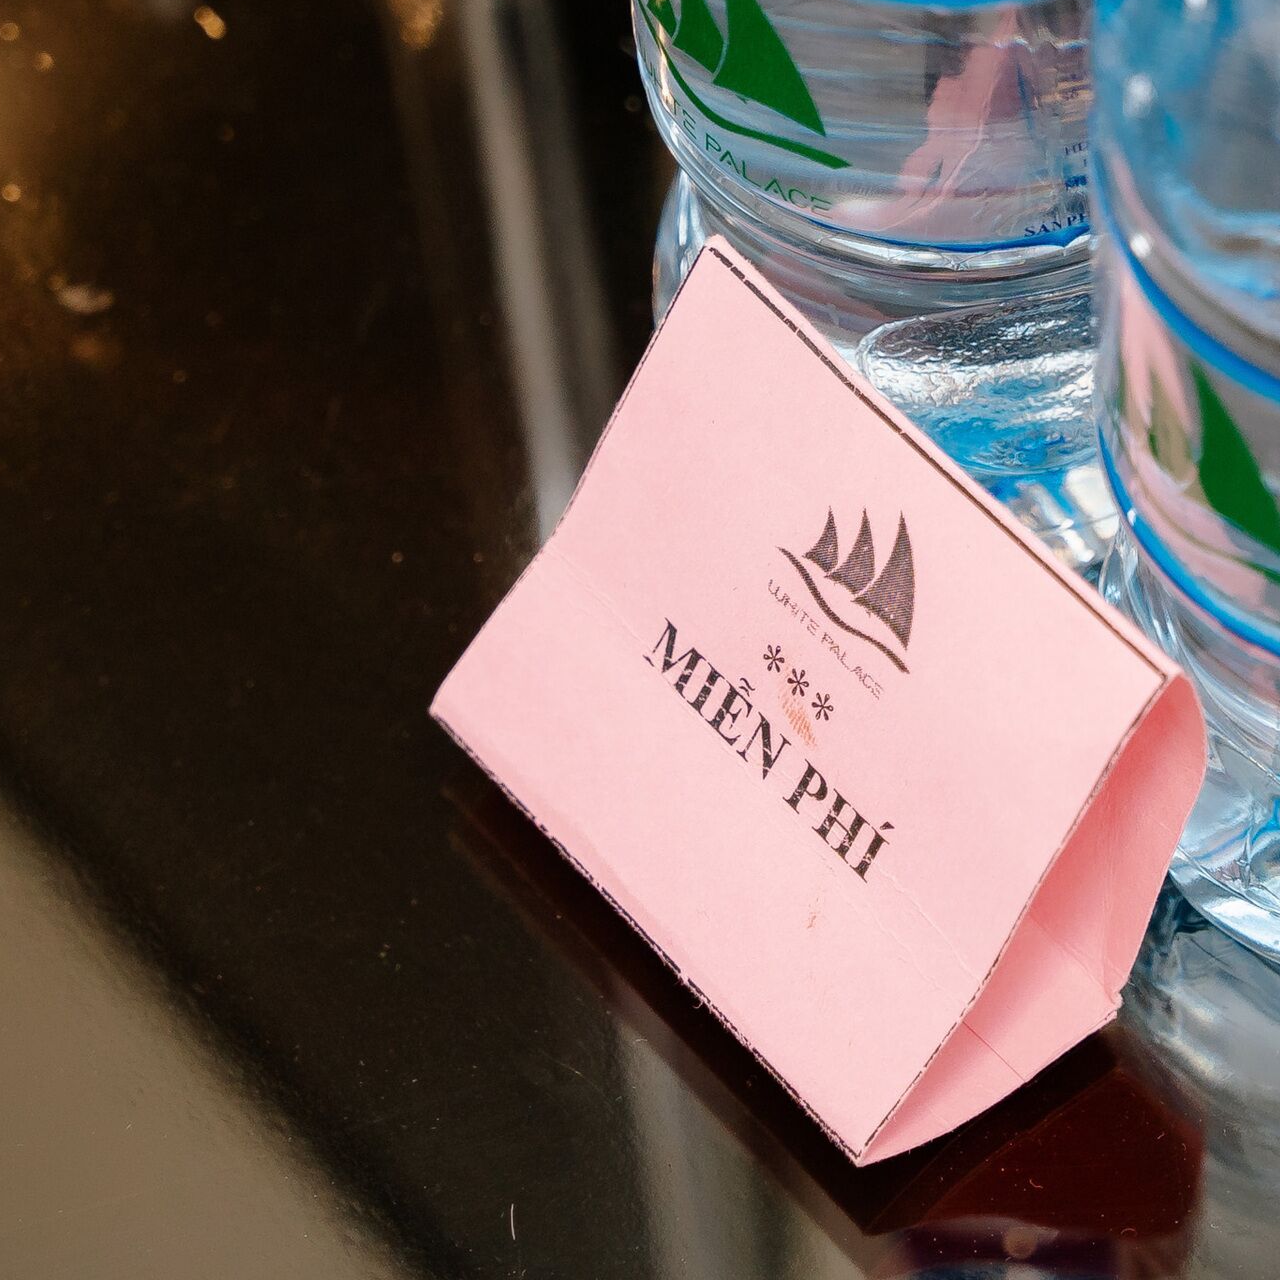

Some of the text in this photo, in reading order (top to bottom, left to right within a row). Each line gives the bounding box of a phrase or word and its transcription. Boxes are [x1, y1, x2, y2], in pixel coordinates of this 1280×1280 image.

[706, 133, 833, 219] PALACE
[767, 578, 884, 700] WHITE PALACE
[642, 616, 895, 884] MIỄN PHÍ
